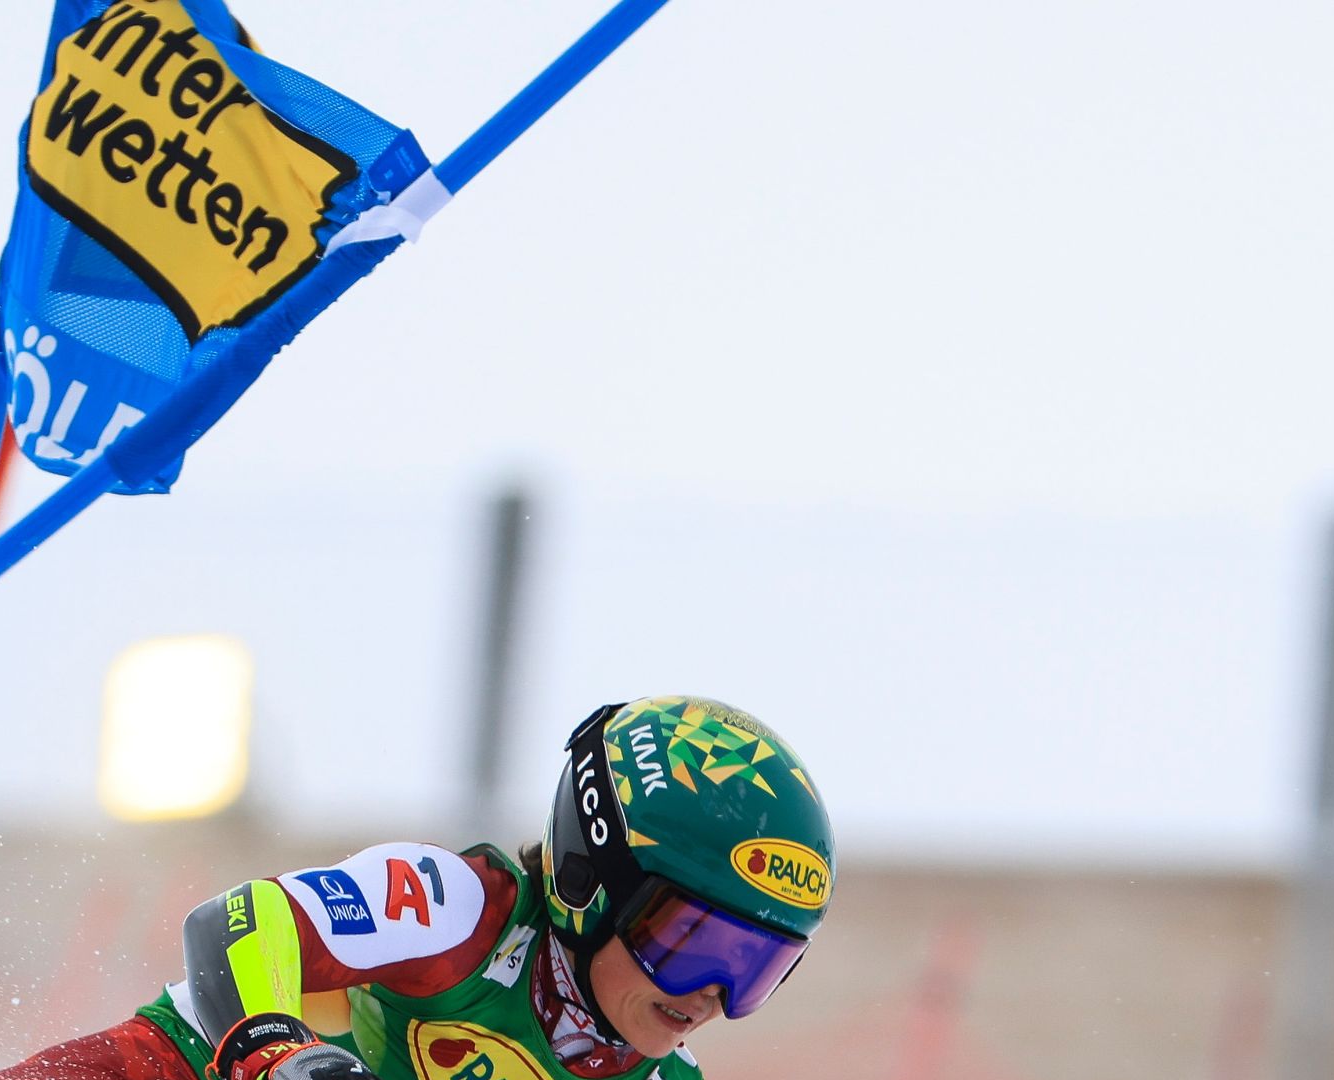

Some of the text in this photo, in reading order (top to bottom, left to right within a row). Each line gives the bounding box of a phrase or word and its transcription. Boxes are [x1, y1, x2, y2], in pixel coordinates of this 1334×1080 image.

[44, 74, 290, 275] wetten
[629, 724, 668, 797] KASK
[384, 856, 445, 927] A1
[768, 853, 827, 899] RAUCH
[226, 883, 248, 932] LEKI
[326, 904, 369, 922] UNIQA
